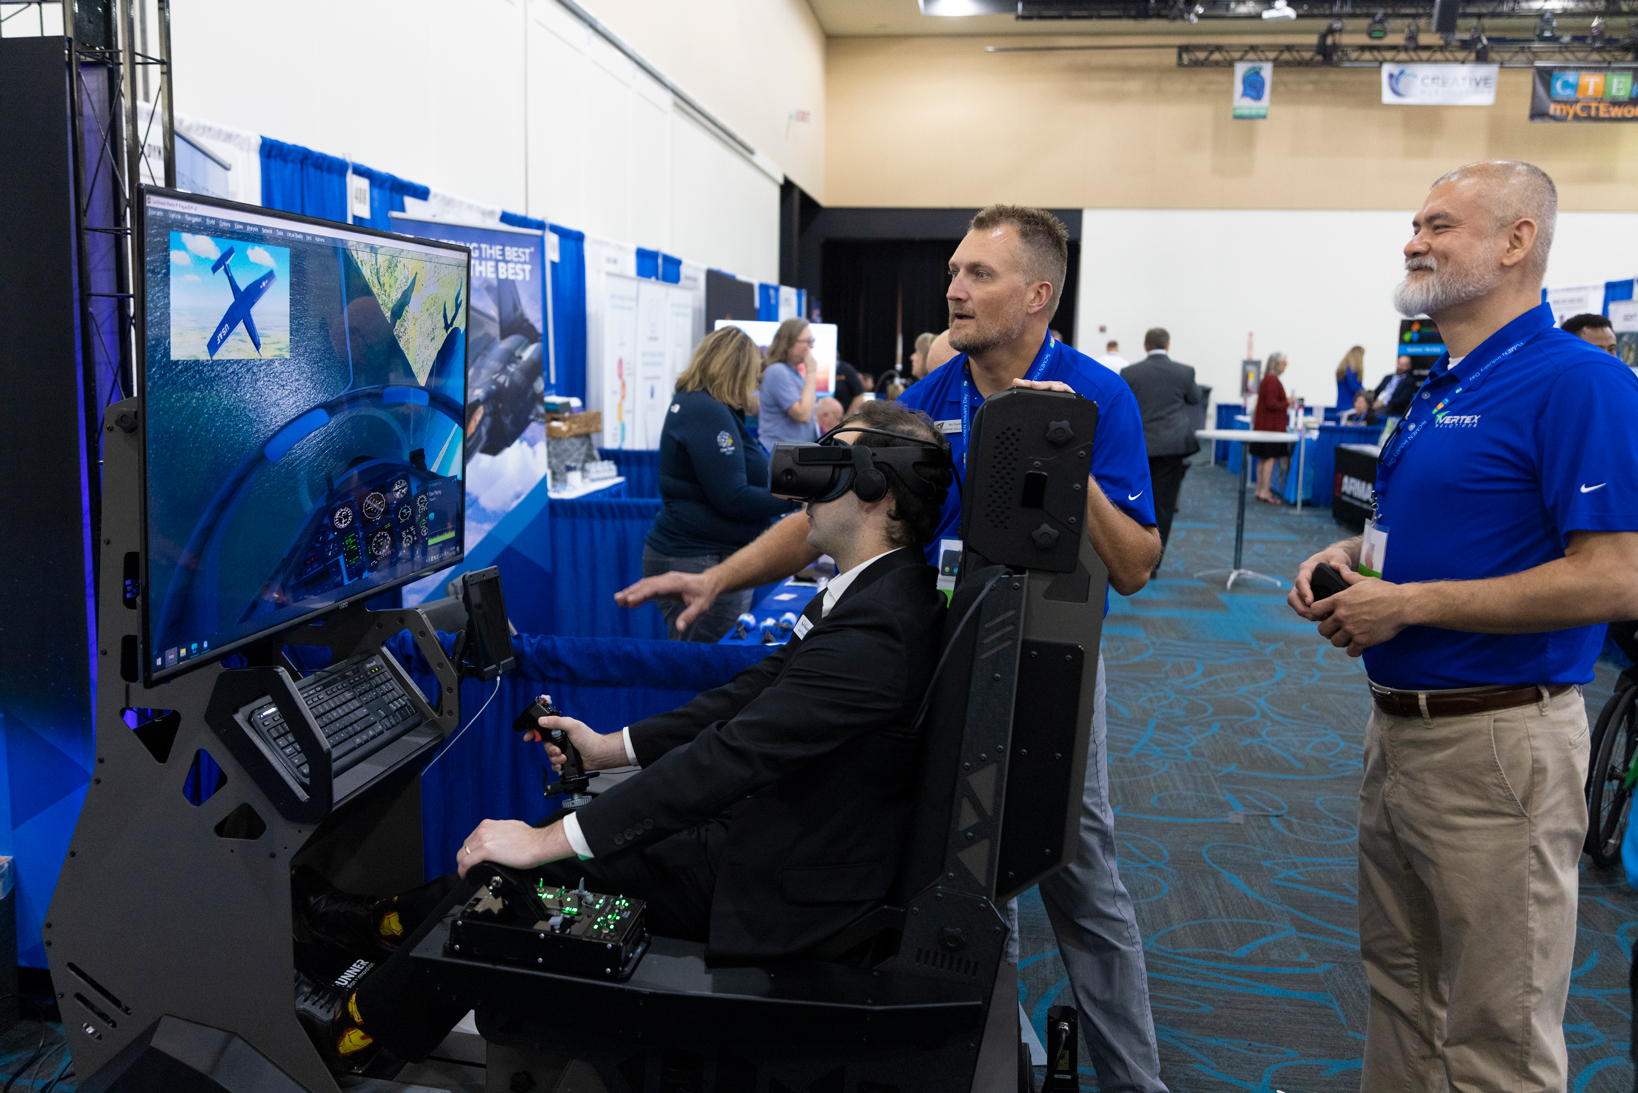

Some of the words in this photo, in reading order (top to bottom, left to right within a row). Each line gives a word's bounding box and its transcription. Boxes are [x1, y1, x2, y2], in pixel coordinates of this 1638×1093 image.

[1420, 74, 1493, 89] CREATIVE
[480, 243, 503, 260] THE
[498, 261, 532, 281] BEST
[216, 323, 230, 345] USAF
[1480, 355, 1502, 372] Industry
[1469, 371, 1481, 382] Day
[1437, 414, 1482, 424] VERTEX
[1392, 439, 1410, 459] Industry
[333, 958, 370, 987] UNNER
